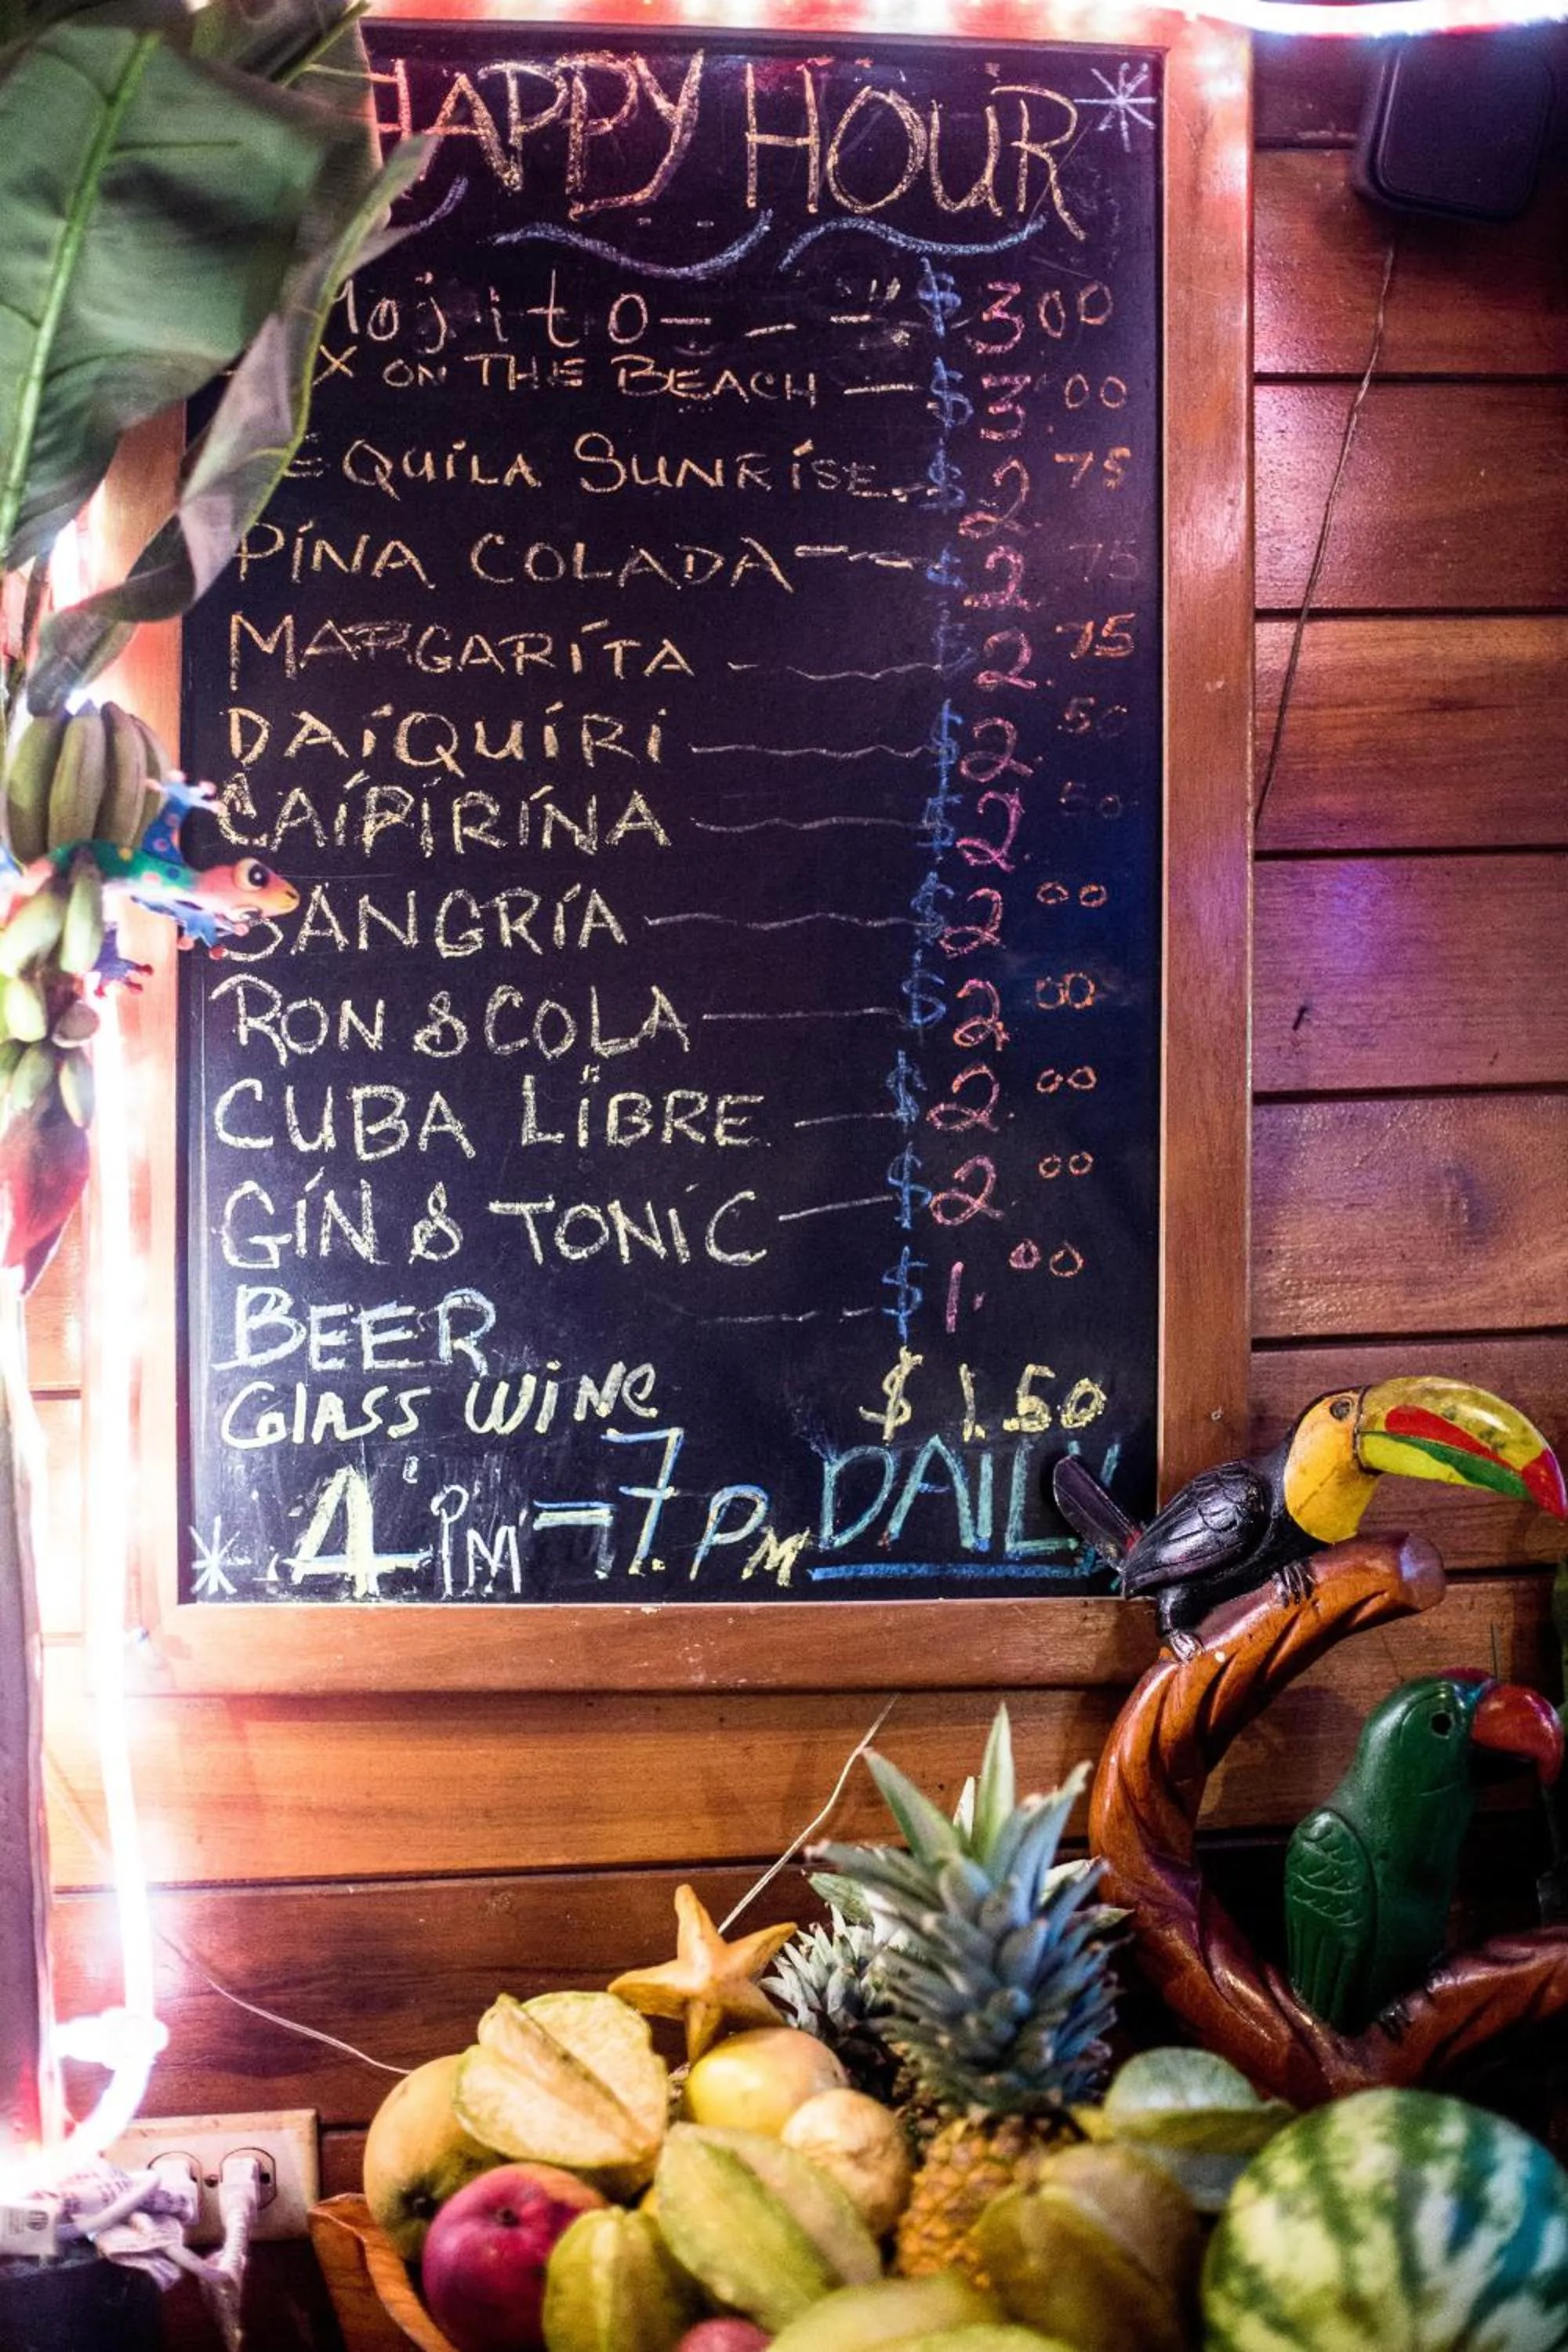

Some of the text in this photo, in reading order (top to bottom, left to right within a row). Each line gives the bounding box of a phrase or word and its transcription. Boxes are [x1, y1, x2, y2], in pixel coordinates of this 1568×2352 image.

[744, 61, 1086, 241] HOUR
[383, 358, 446, 387] ON
[464, 351, 586, 390] THE
[611, 353, 817, 408] BEACH
[284, 432, 543, 501] EQUiLA
[471, 532, 794, 594] COLADA
[210, 974, 385, 1066] RON
[484, 985, 691, 1058] COLA
[215, 1079, 476, 1162] CUBA
[212, 1283, 496, 1377] BEER
[688, 1484, 811, 1587] PM
